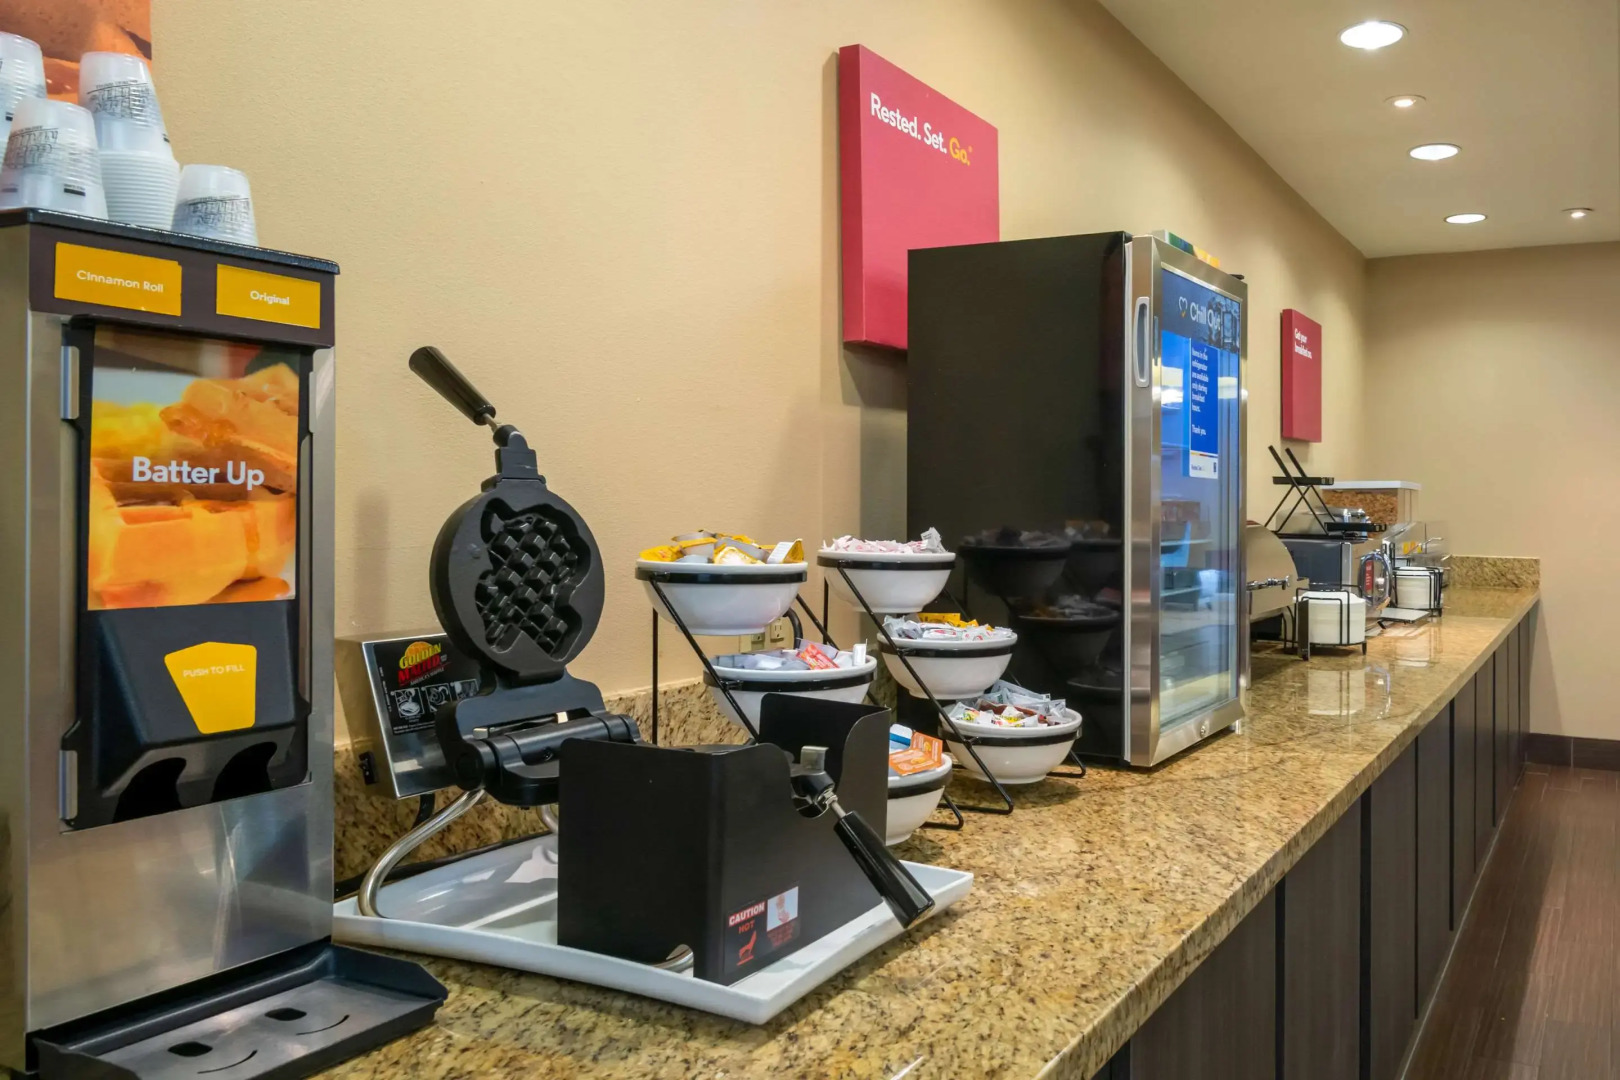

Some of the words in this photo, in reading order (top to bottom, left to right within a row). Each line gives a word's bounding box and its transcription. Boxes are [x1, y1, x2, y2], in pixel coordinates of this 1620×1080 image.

[870, 92, 921, 141] Rested.
[924, 122, 947, 154] Set.
[143, 281, 164, 293] Roll
[250, 290, 290, 306] Original
[1190, 301, 1207, 325] Chill
[1207, 309, 1221, 331] Out
[132, 456, 220, 485] Batter
[226, 460, 265, 490] Up
[183, 667, 209, 678] PUSH
[210, 665, 225, 675] TO
[226, 663, 245, 673] FILL
[729, 902, 766, 927] CAUTION
[738, 920, 755, 934] HOT
